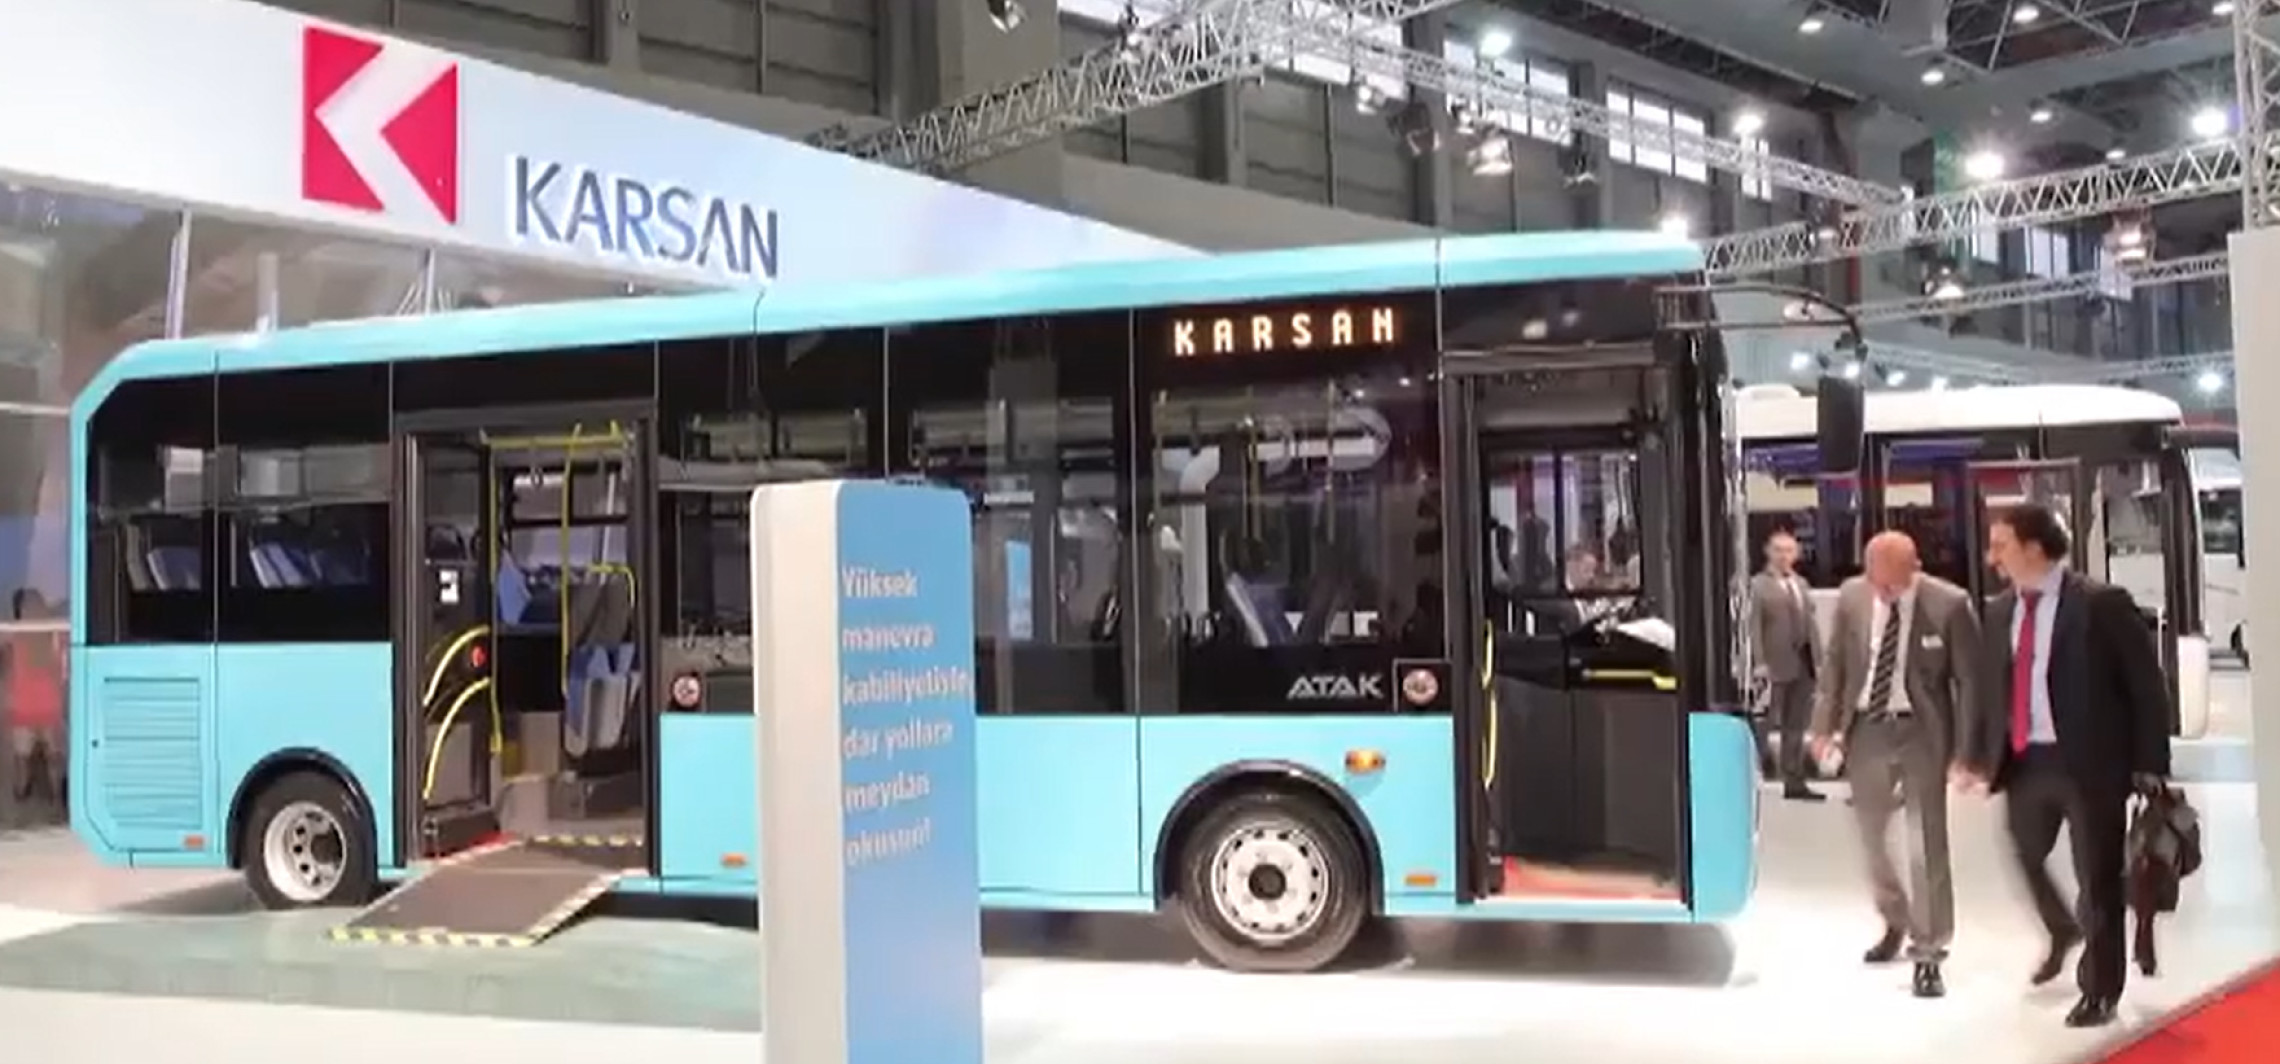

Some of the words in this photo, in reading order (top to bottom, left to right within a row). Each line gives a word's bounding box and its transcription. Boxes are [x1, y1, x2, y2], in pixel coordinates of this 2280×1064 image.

[516, 155, 778, 279] KARSAN
[1174, 307, 1394, 357] KARSAN
[841, 566, 917, 598] Yüksek
[1286, 673, 1384, 700] ATAK
[844, 727, 878, 759] dar
[884, 715, 953, 761] yollara
[844, 770, 930, 814] meydan
